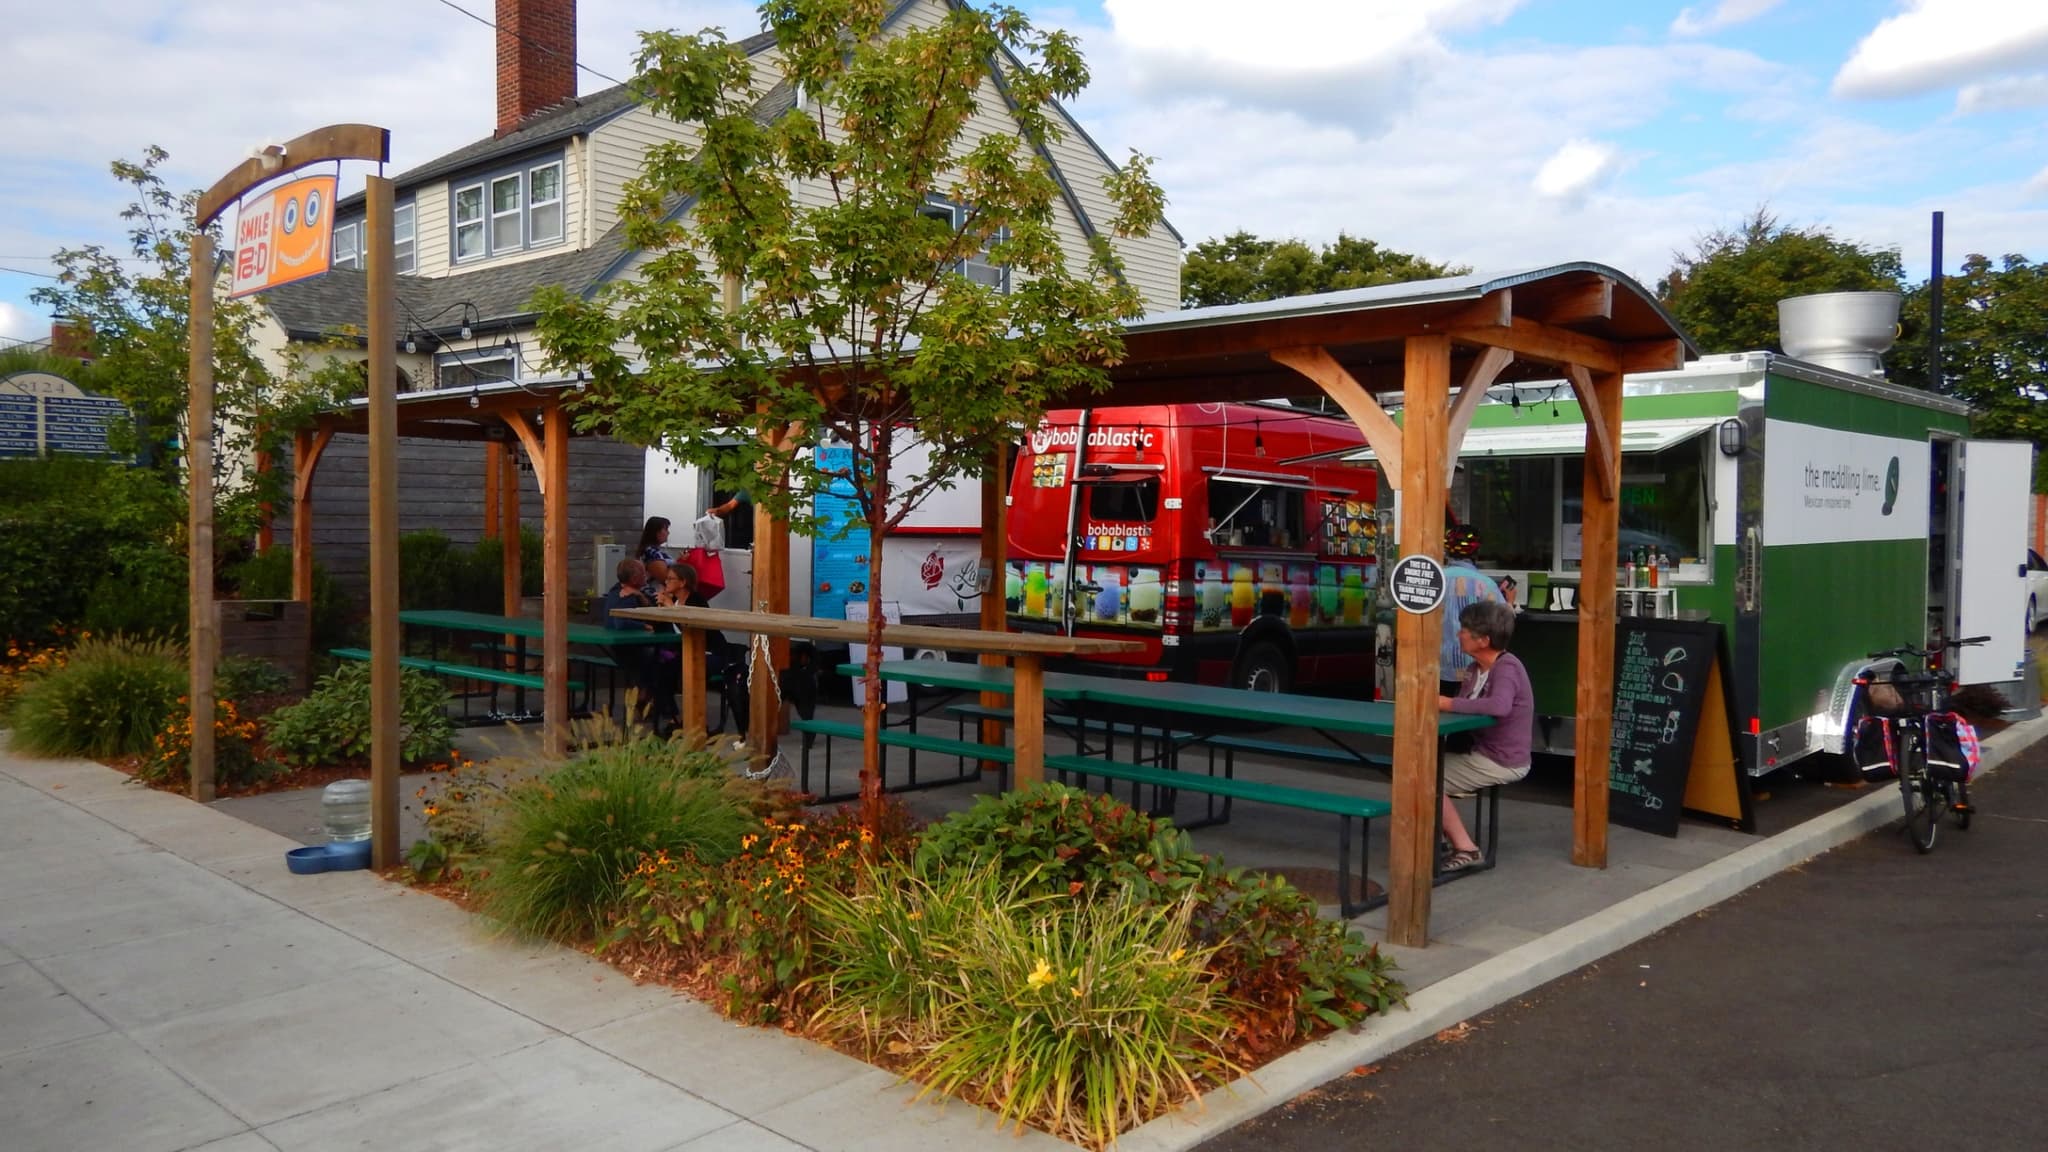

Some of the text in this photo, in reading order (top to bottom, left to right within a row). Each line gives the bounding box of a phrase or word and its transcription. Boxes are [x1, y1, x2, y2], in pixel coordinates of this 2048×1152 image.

[240, 212, 270, 245] SMILE
[1805, 461, 1819, 488] the
[1822, 464, 1860, 496] meddling
[1622, 487, 1655, 505] PEN
[1421, 570, 1434, 578] FREE
[1406, 576, 1431, 585] PROPERTY
[1399, 586, 1415, 594] THANK
[1410, 595, 1433, 605] SMOKING
